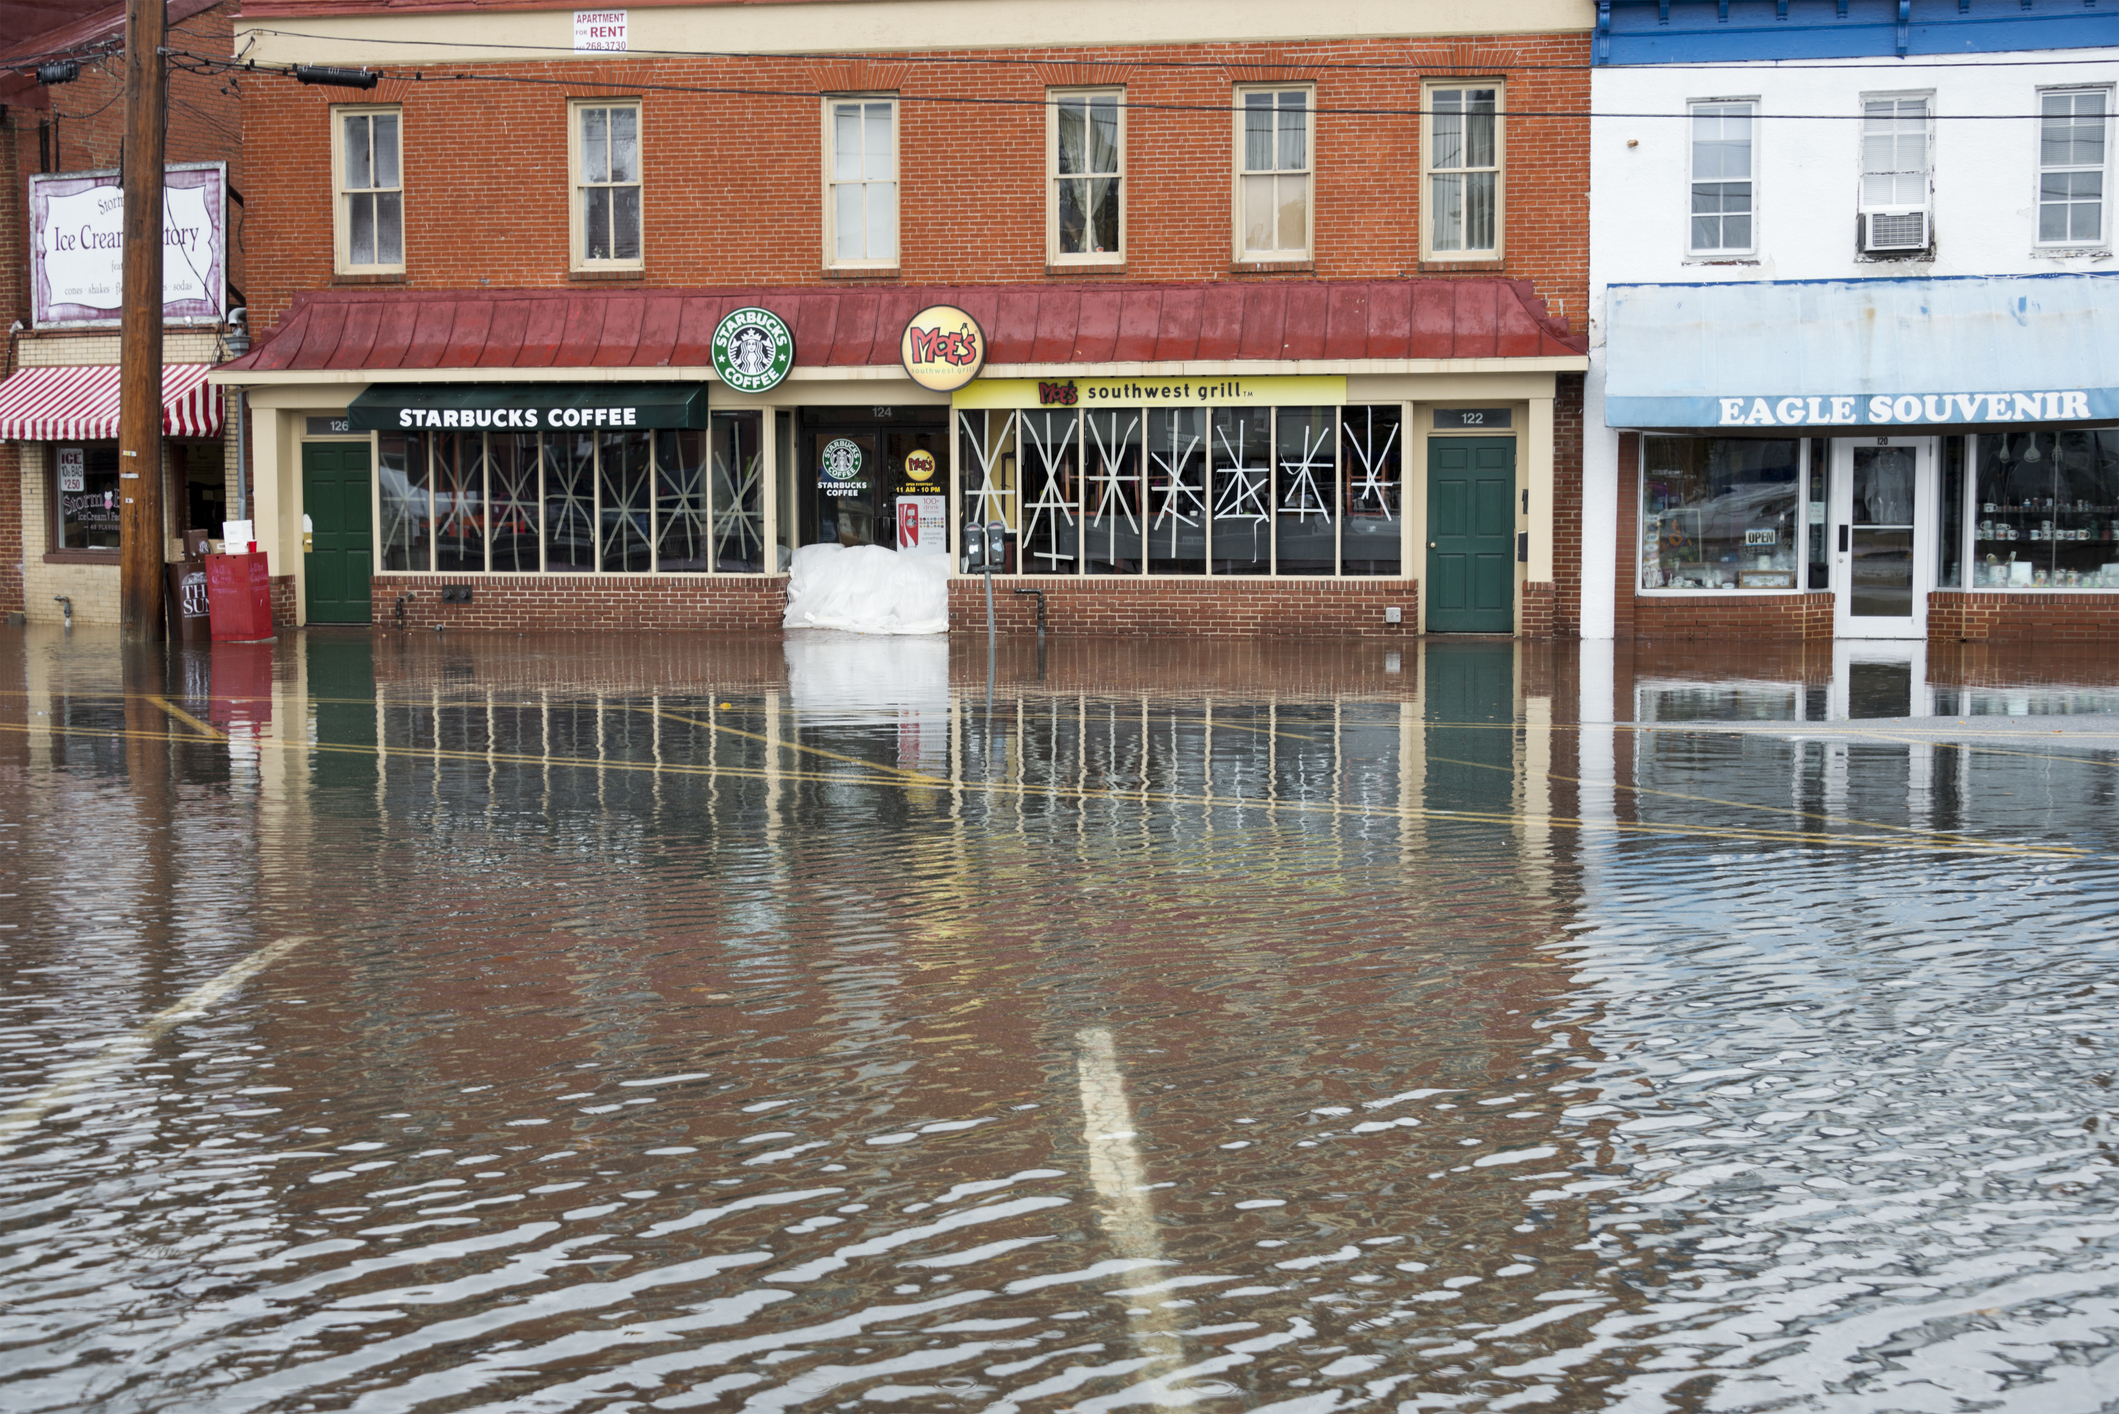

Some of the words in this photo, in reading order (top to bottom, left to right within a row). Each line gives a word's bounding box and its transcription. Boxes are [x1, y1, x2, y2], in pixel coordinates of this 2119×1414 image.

[576, 13, 625, 24] APARTMENT
[590, 26, 626, 38] RENT
[586, 41, 627, 51] 268-3730
[54, 226, 76, 251] Ice
[64, 284, 83, 296] cones
[88, 282, 110, 295] shakes
[172, 279, 193, 291] sodas
[715, 311, 788, 348] STARBUCKS
[957, 366, 975, 374] grill
[724, 367, 780, 389] COFFEE
[1088, 383, 1190, 399] southwest
[1198, 382, 1240, 400] grill
[872, 406, 893, 418] 124
[1718, 396, 1857, 425] EAGLE
[1868, 391, 2092, 424] SOUVENIR
[399, 408, 538, 427] STARBUCKS
[547, 407, 636, 426] COFFEE
[1461, 412, 1484, 424] 122
[330, 420, 349, 431] 126
[1877, 436, 1889, 446] 120
[824, 440, 860, 459] STARBUCKS
[61, 452, 82, 465] ICE
[71, 465, 83, 478] BAG
[828, 466, 856, 478] COFFEE
[817, 481, 867, 489] STARBUCKS
[826, 489, 859, 497] COFFEE
[62, 493, 104, 516] Storm
[1748, 530, 1774, 544] OPEN
[181, 584, 207, 599] TH
